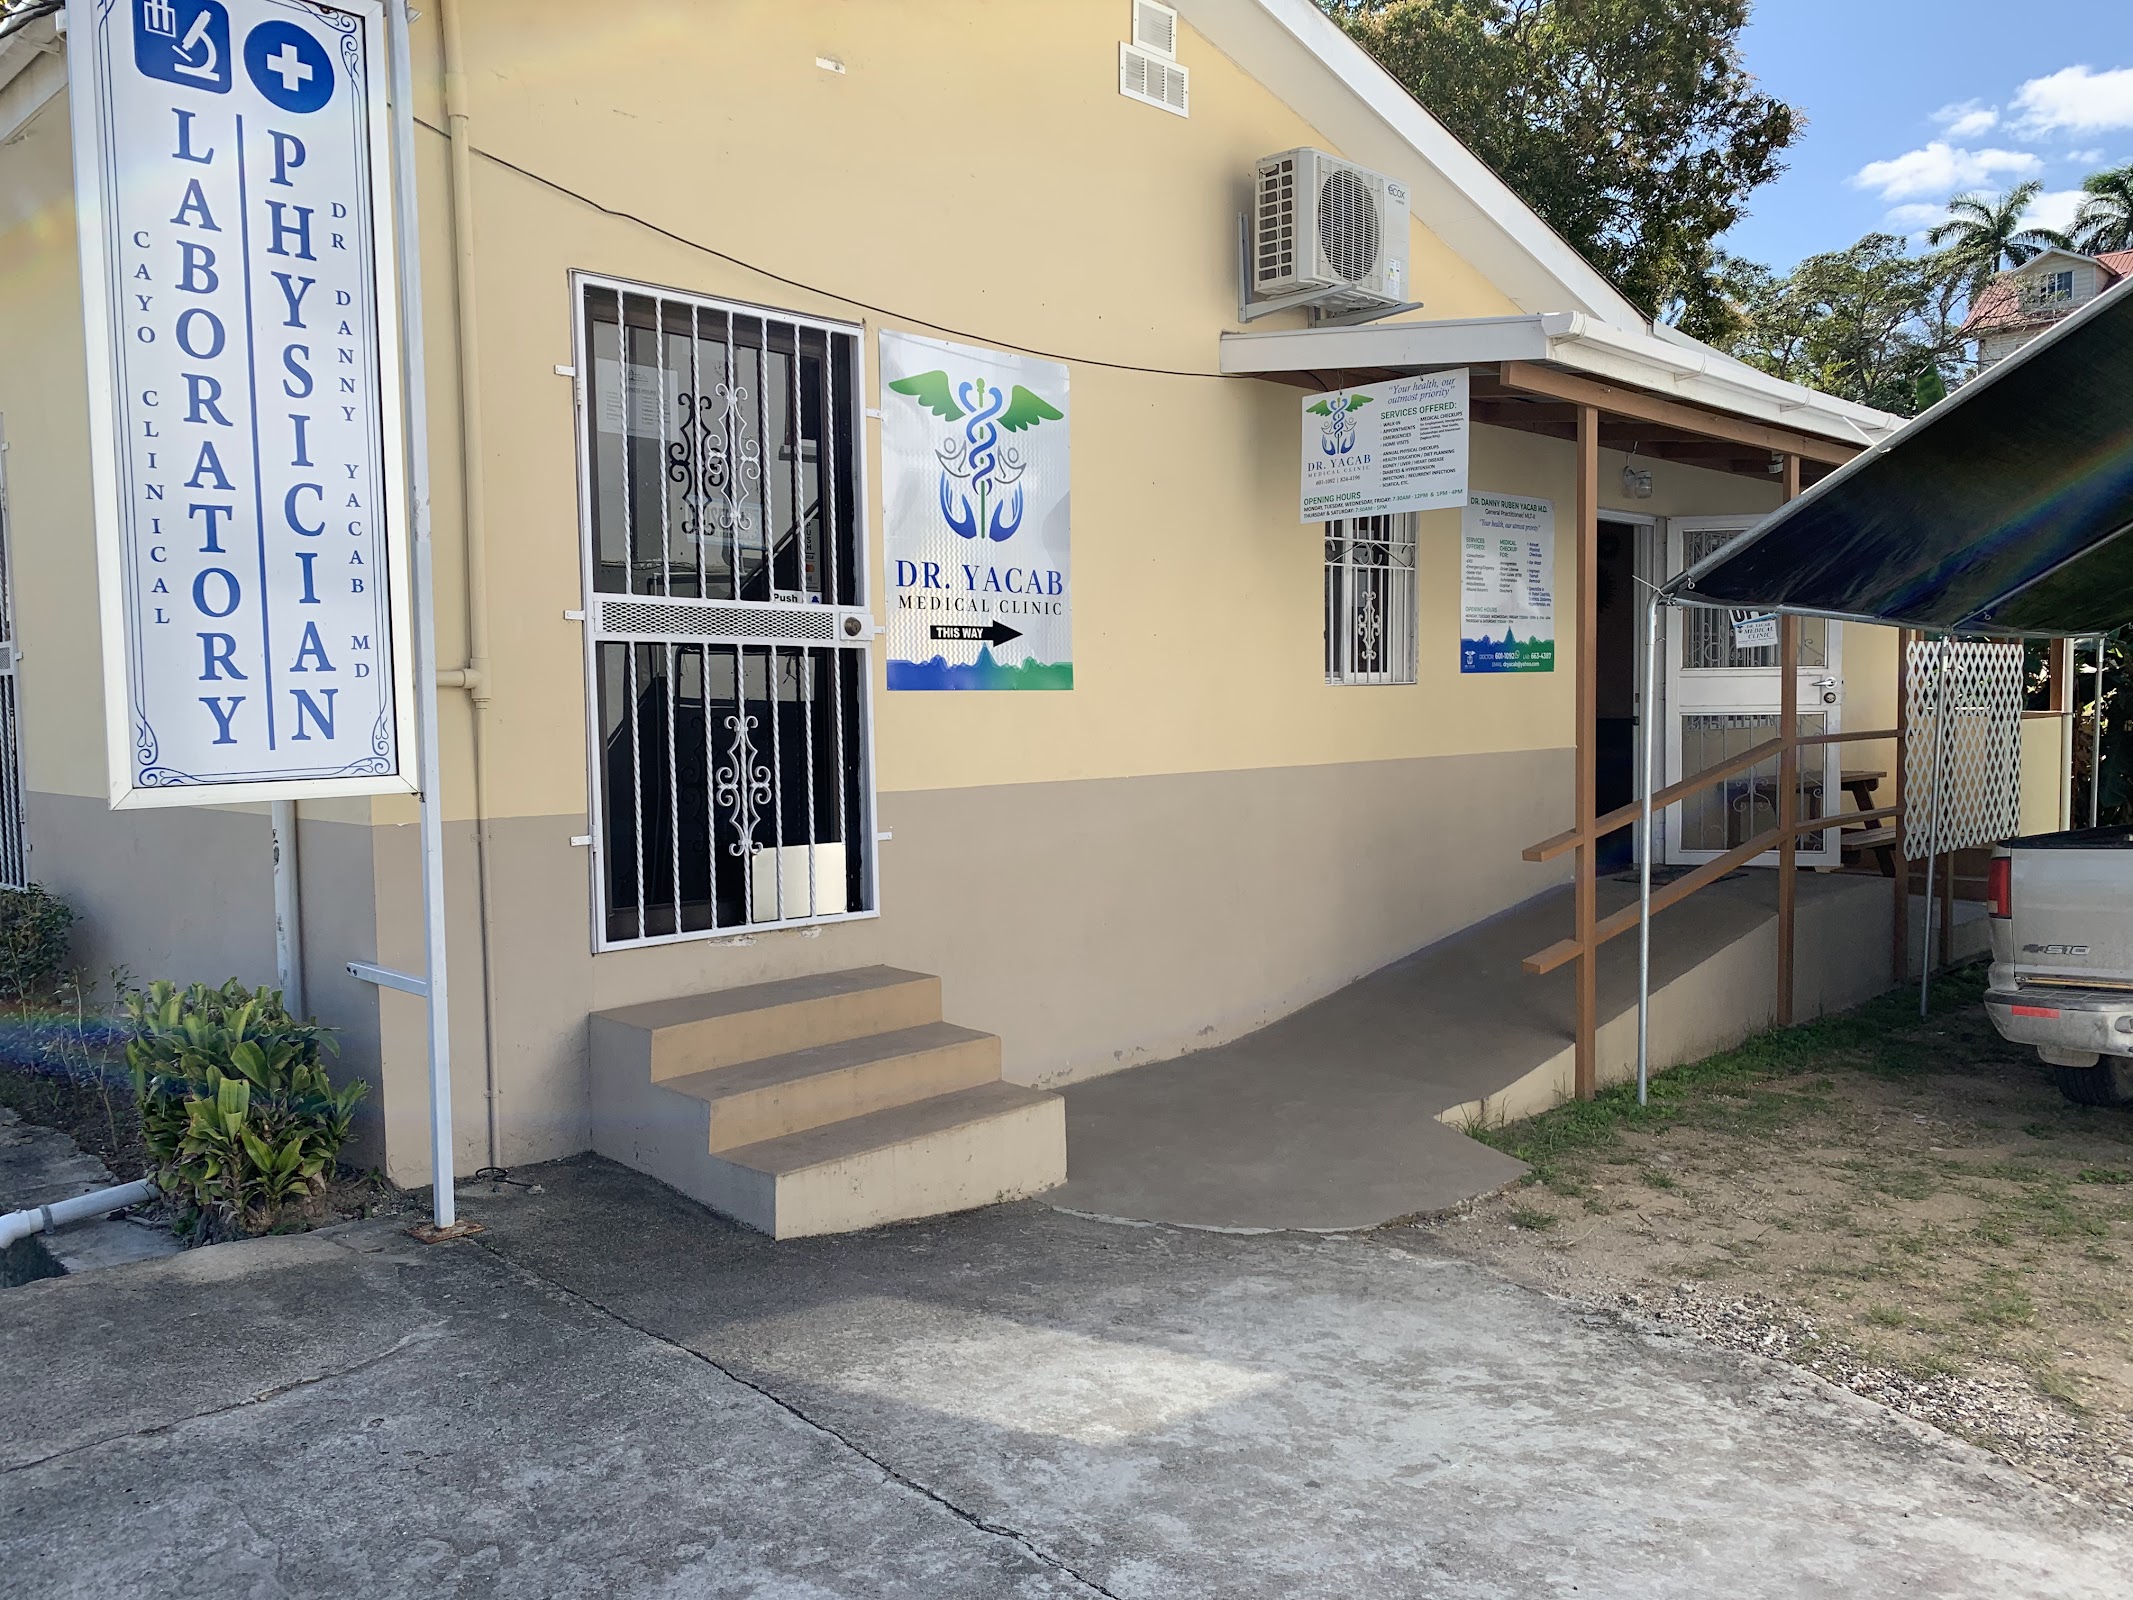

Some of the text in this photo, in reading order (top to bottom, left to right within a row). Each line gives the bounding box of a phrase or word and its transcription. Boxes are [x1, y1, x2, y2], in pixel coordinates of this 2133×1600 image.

[1412, 378, 1439, 392] health,
[1441, 377, 1457, 386] our
[1380, 401, 1457, 420] SERVICES OFFERED:
[1420, 410, 1463, 422] MEDICAL CHECKUPS
[133, 230, 171, 624] CAYO CLINICAL
[170, 108, 248, 745] LABORATORY
[1382, 424, 1416, 434] APPOINTMENTS
[265, 129, 338, 741] PHYSICIAN
[330, 201, 371, 678] DR DANNY YACAB MD
[1382, 432, 1412, 441] EMERGENCIES
[1397, 453, 1421, 461] EDUCATION
[1433, 448, 1455, 456] PLANNING
[1418, 444, 1440, 452] CHECKUPS
[1307, 454, 1371, 472] DR. YACAB
[1405, 464, 1436, 472] HYPERTENSION
[1307, 465, 1371, 478] MEDICAL CLINIC
[1382, 474, 1405, 482] INFECTIONS
[1407, 470, 1431, 478] RECURRENT
[1431, 468, 1456, 476] INFECTIONS
[1303, 491, 1361, 506] OPENING HOURS
[1344, 499, 1373, 507] WEDNESDAY,
[1470, 497, 1480, 505] DR.
[1481, 498, 1500, 508] DANNY
[1501, 500, 1520, 510] RUBEN
[1520, 502, 1538, 512] YACAB
[1303, 511, 1325, 519] THURSDAY
[1484, 508, 1500, 516] General
[1465, 536, 1485, 544] SERVICES
[895, 559, 1064, 597] DR. YACAB
[773, 593, 798, 604] Push
[898, 594, 1062, 616] MEDICAL CLINIC
[936, 626, 984, 640] THIS WAY
[1744, 626, 1774, 635] MEDICAL
